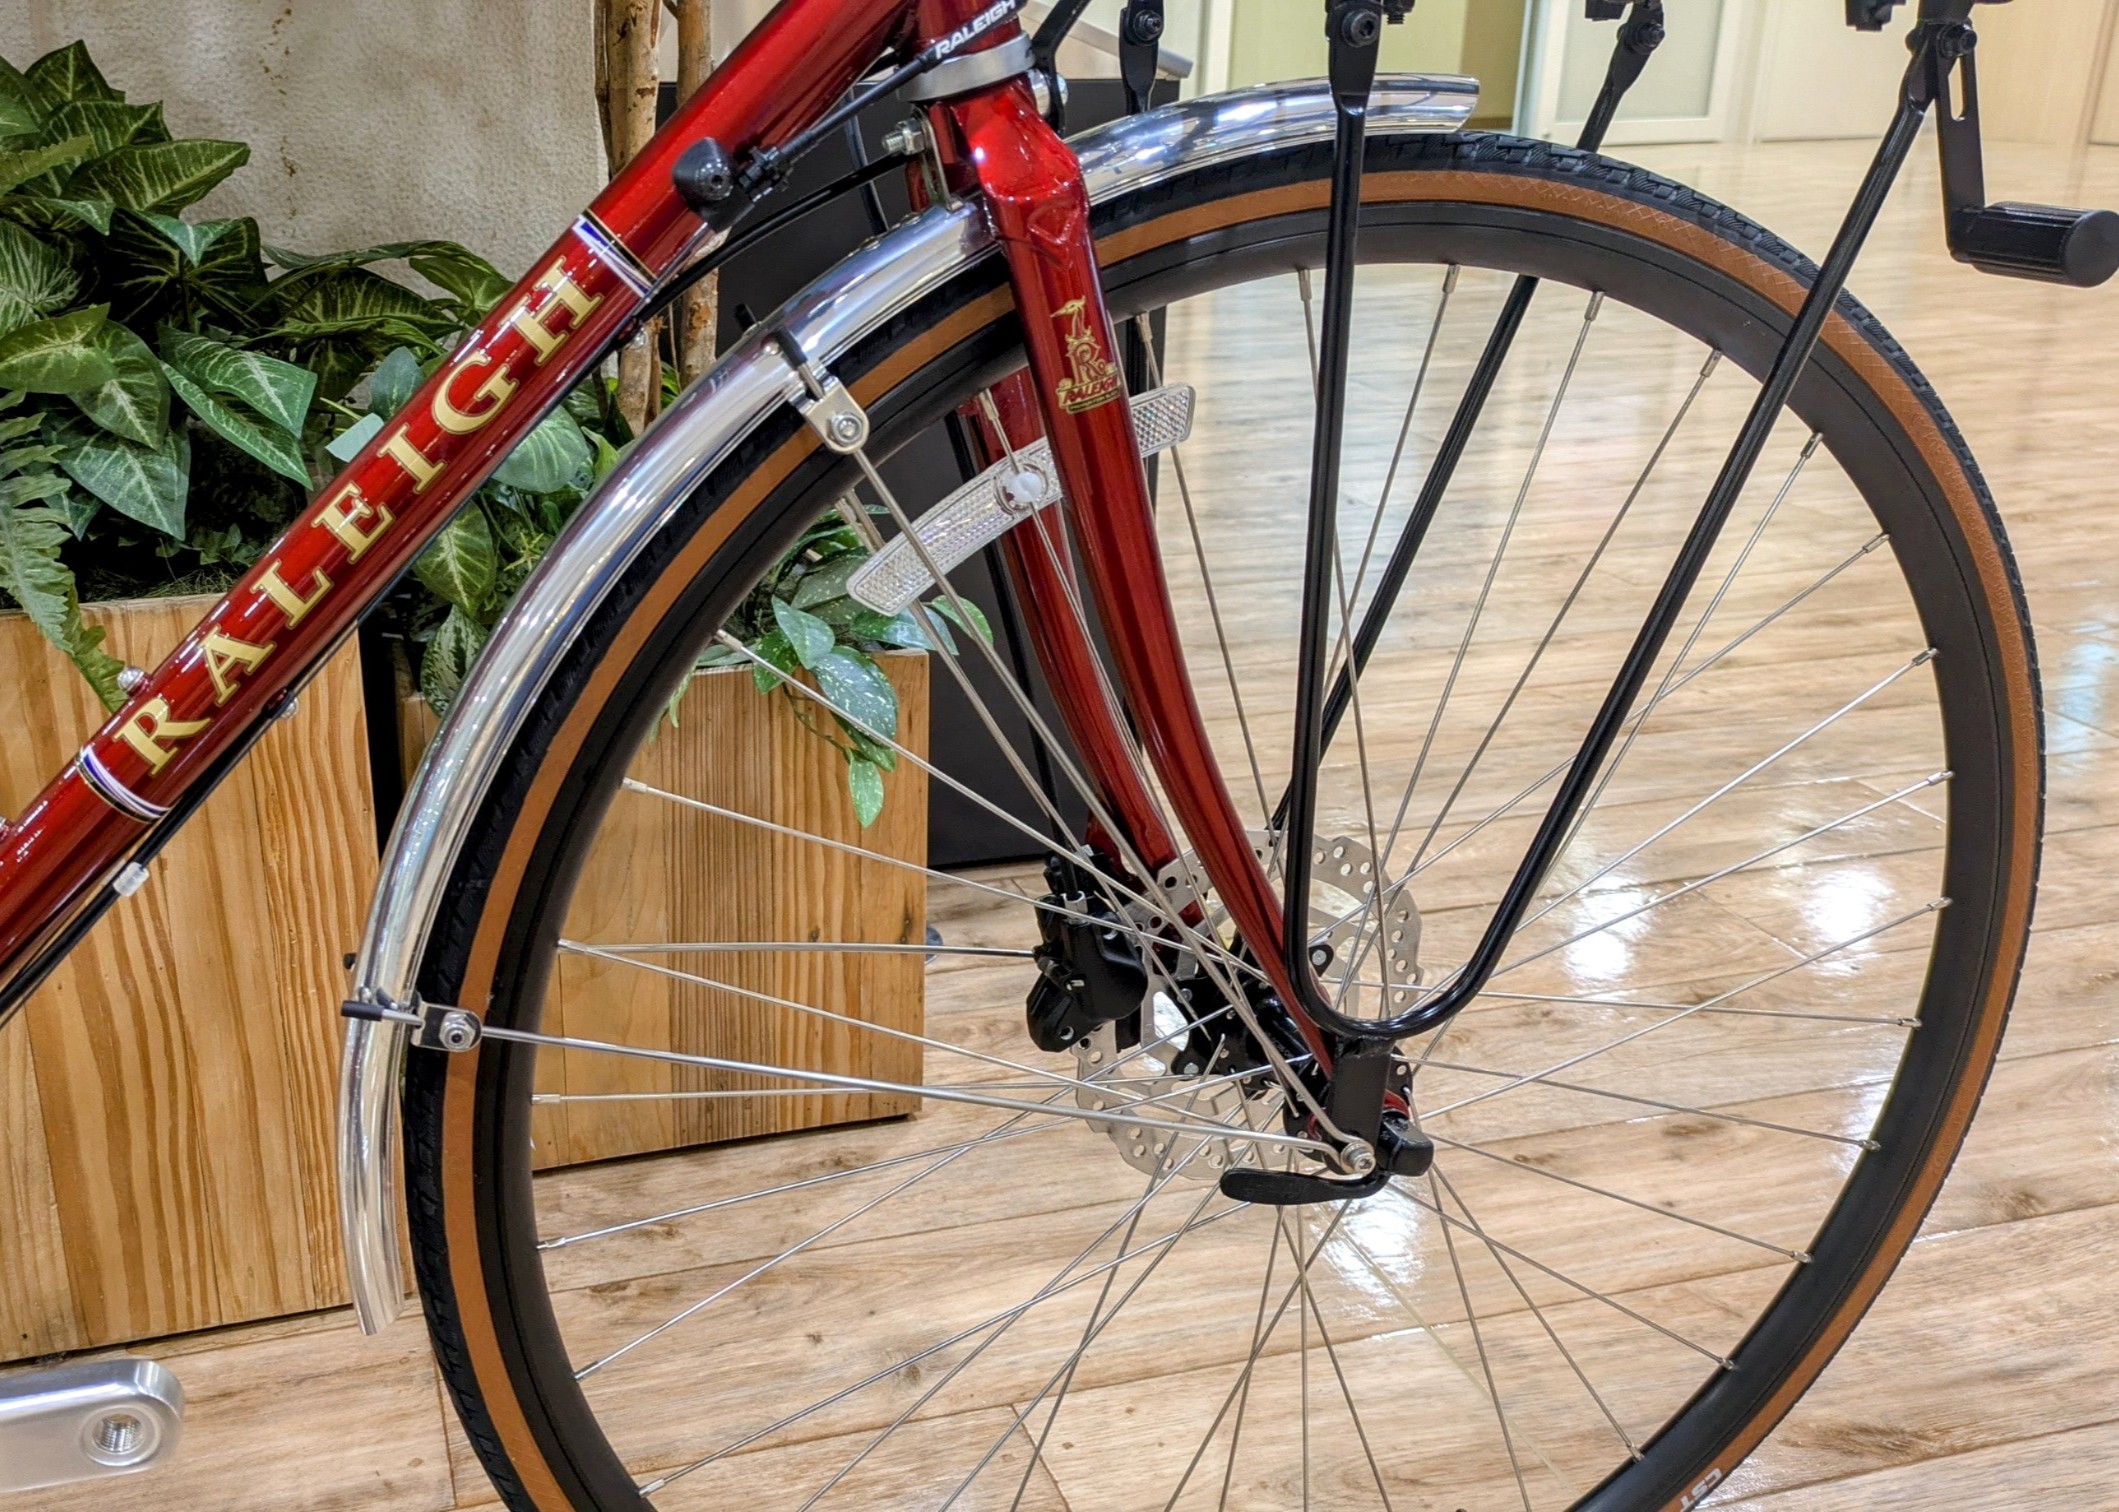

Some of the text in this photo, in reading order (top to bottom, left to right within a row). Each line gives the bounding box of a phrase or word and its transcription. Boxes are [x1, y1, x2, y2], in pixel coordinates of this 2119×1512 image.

[935, 0, 1016, 60] RALEIGH
[112, 256, 603, 776] RALEIGH
[1679, 1467, 1723, 1512] CST
